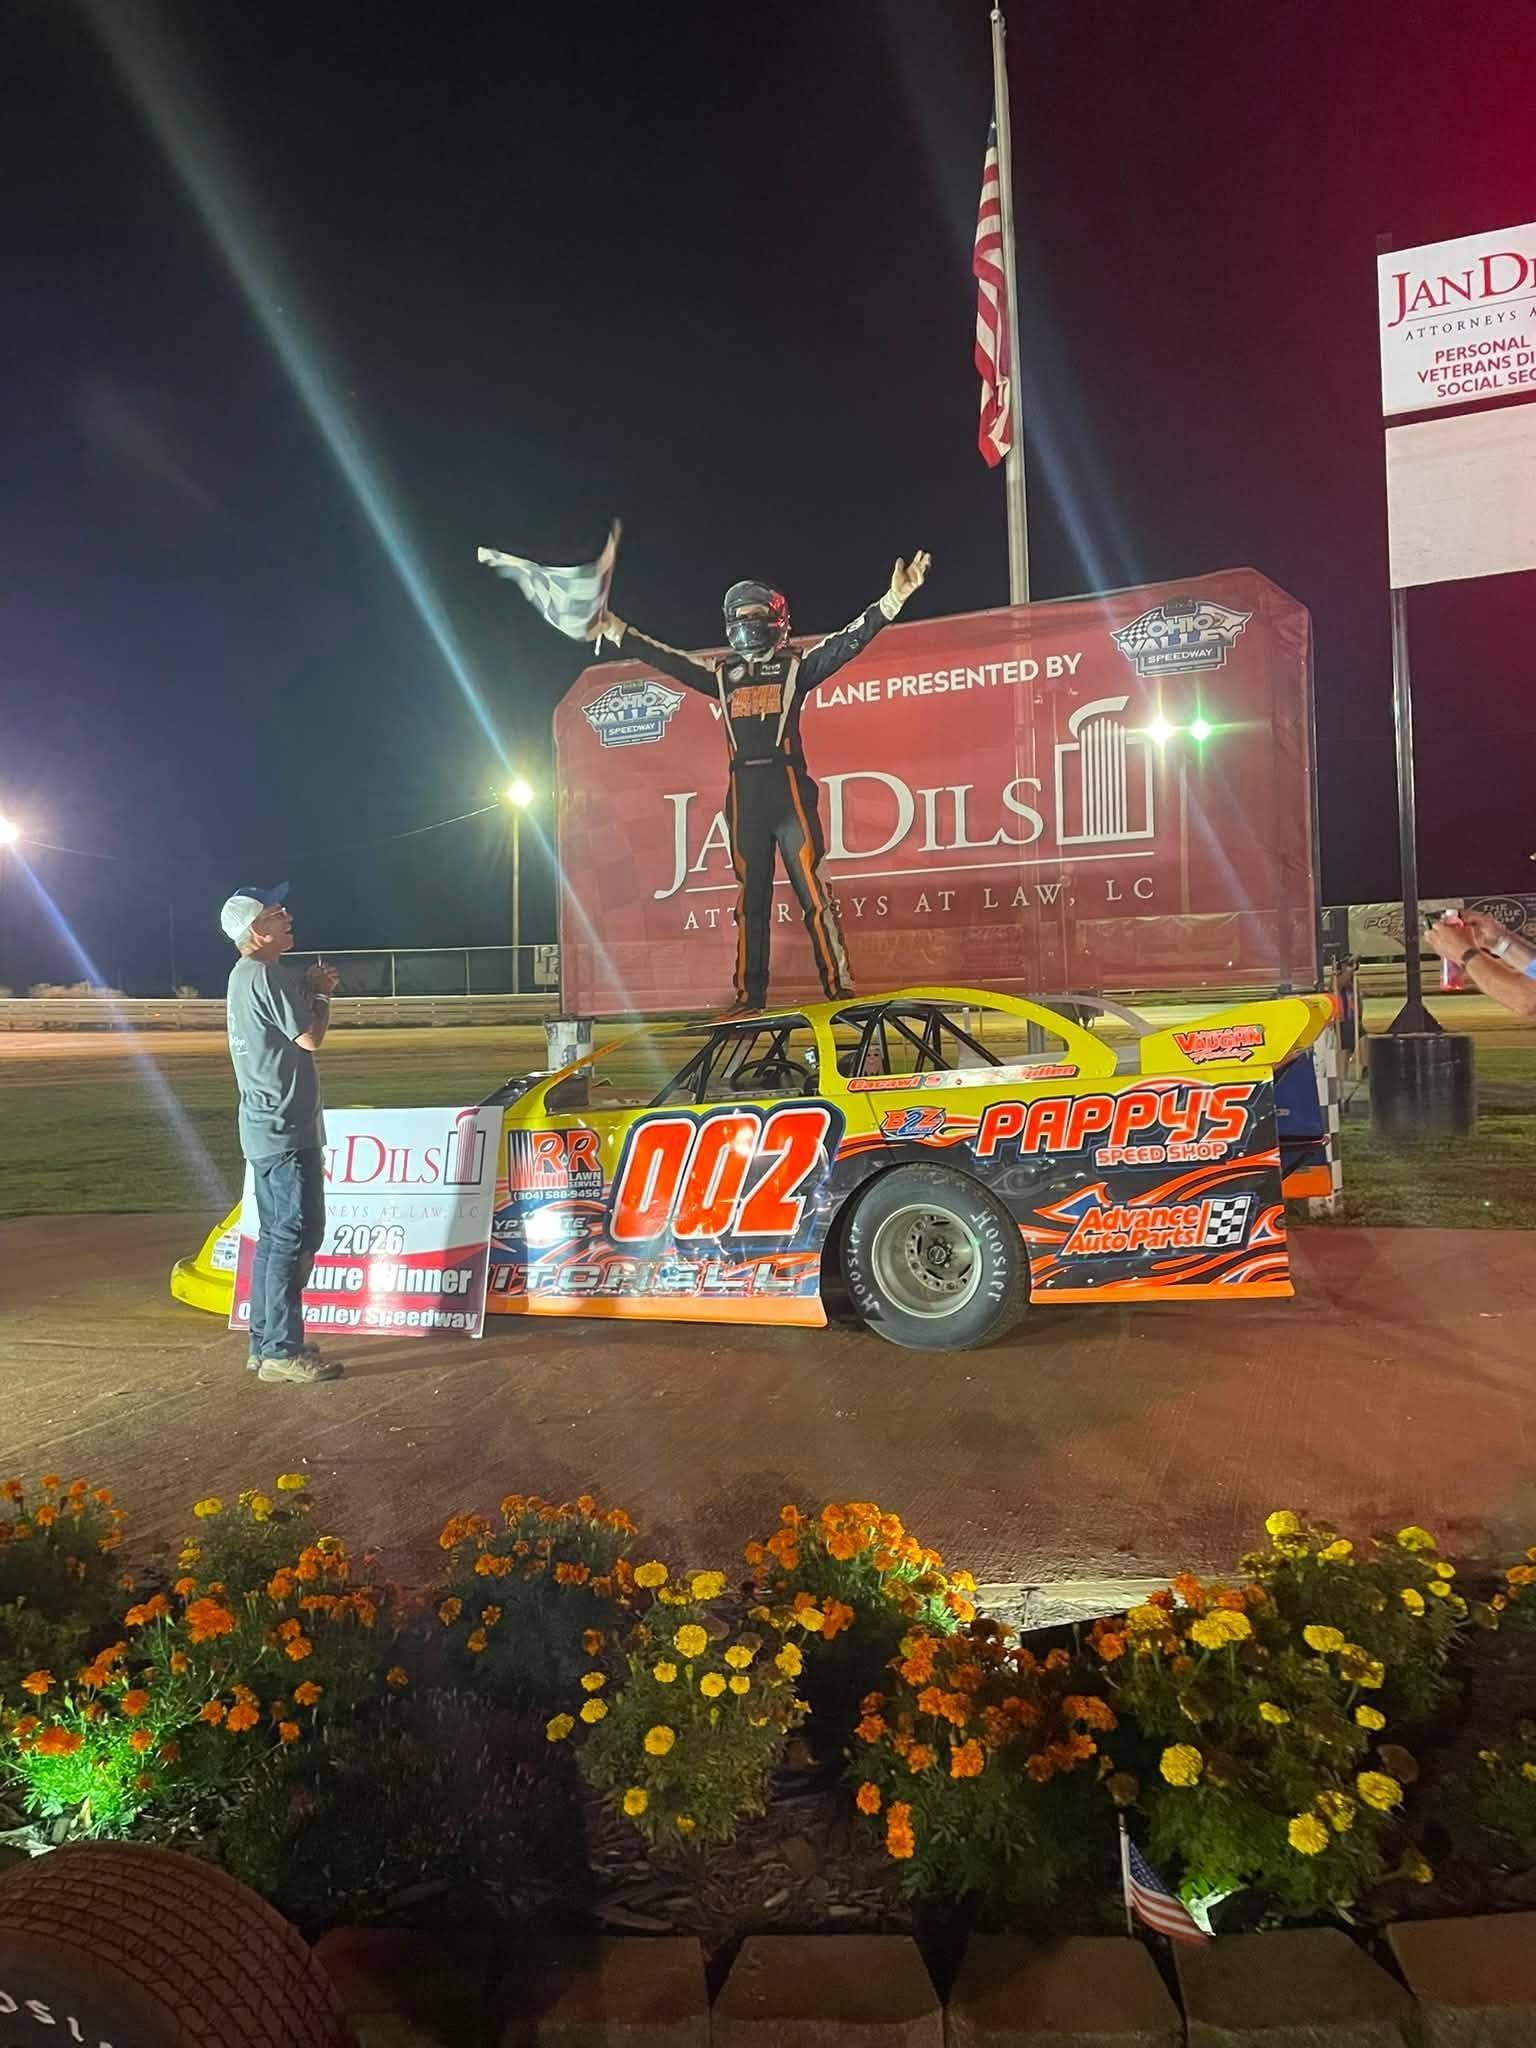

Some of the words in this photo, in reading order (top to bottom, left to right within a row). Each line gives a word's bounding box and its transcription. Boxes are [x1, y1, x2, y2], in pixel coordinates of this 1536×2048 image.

[1405, 310, 1518, 341] ATTORNEYS
[1435, 335, 1531, 364] PERSONAL
[1417, 355, 1511, 383] VETERANS
[1437, 374, 1503, 398] SOCIAL
[1147, 613, 1214, 637] OHIO
[1119, 626, 1242, 659] VALLEY
[1147, 648, 1214, 664] SPEEDWAY
[815, 681, 881, 709] LANE
[887, 659, 1039, 699] PRESENTED
[1046, 652, 1083, 679] BY
[608, 691, 657, 711] OHIO
[587, 704, 678, 728] VALLEY
[608, 722, 656, 736] SPEEDWAY
[653, 792, 733, 900] JA
[820, 771, 1045, 860] DILS
[914, 890, 956, 913] AT
[983, 883, 1077, 909] LAW,
[1106, 877, 1154, 901] LC
[1095, 1145, 1166, 1167] SPEED
[1167, 1142, 1228, 1162] SHOP
[568, 1172, 602, 1181] LAWN
[609, 1106, 832, 1243] 002
[1078, 1203, 1200, 1233] Advance
[334, 1224, 405, 1256] 2026
[368, 1263, 473, 1294] Winner
[364, 1306, 479, 1331] Speedway
